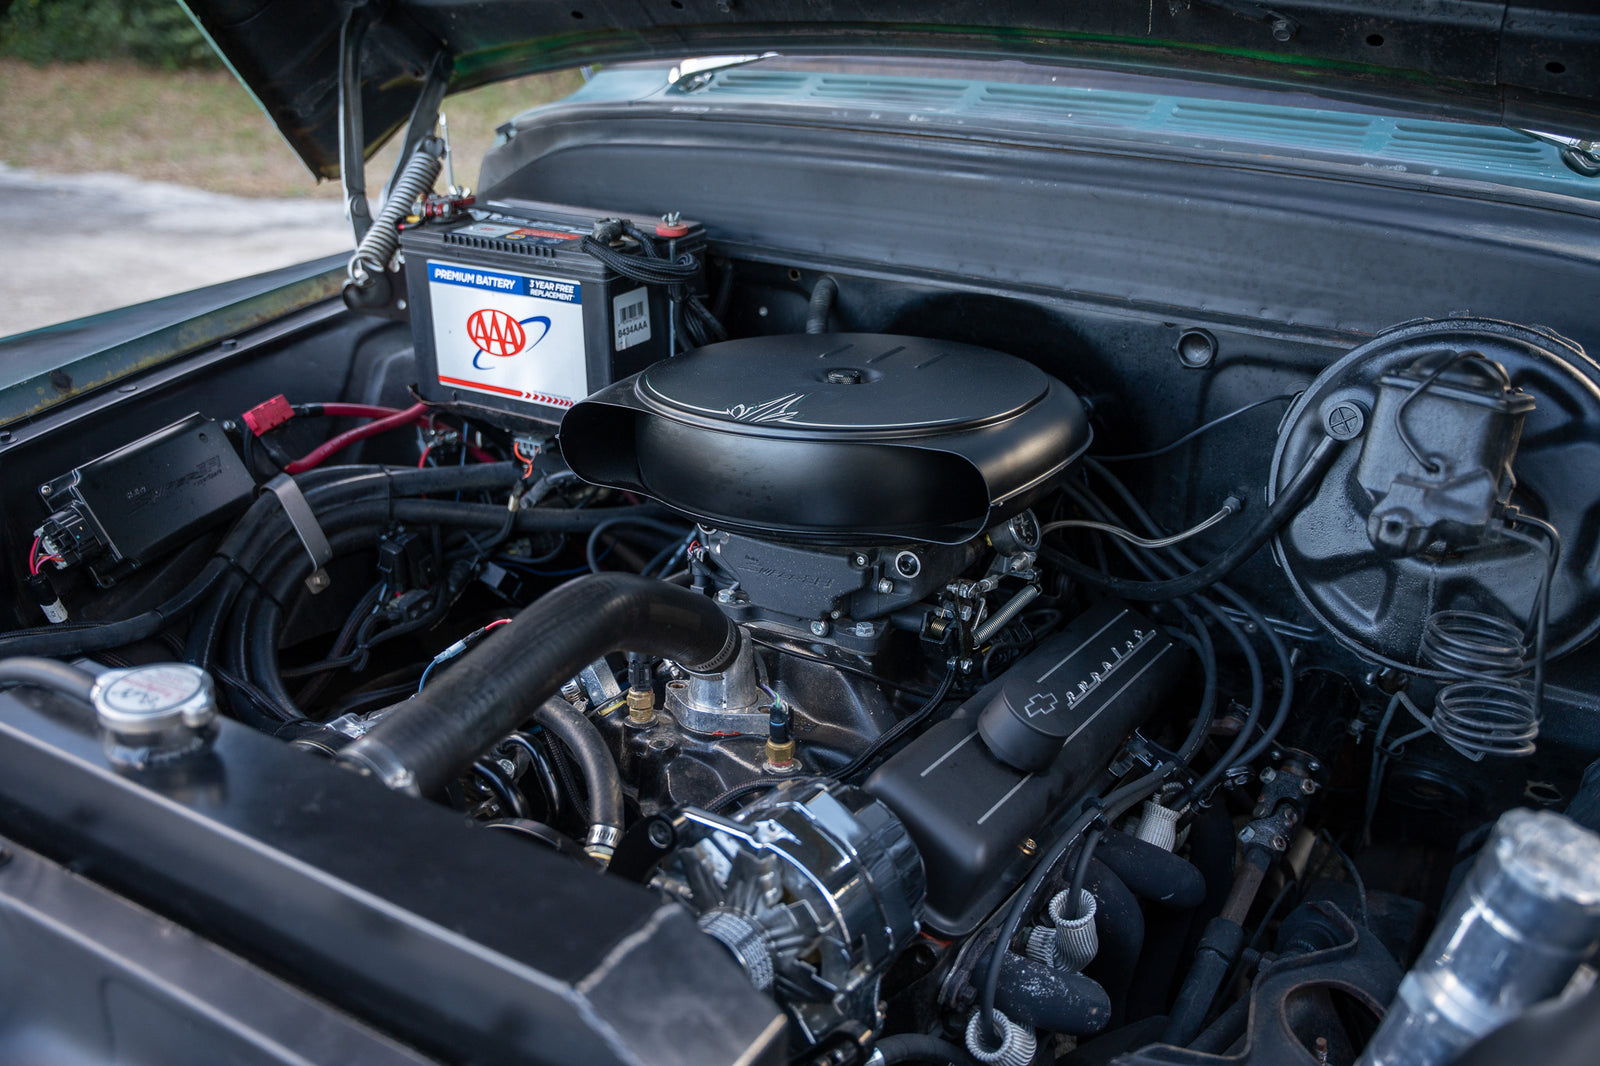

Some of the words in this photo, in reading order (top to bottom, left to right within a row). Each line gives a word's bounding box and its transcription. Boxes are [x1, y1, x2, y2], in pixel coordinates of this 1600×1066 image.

[434, 268, 475, 284] PREMIUM
[476, 274, 516, 290] BATTERY
[529, 279, 535, 288] 3
[535, 281, 554, 291] YEAR
[554, 284, 575, 294] FREE
[473, 310, 522, 356] AAA
[617, 320, 648, 338] 8434AAA
